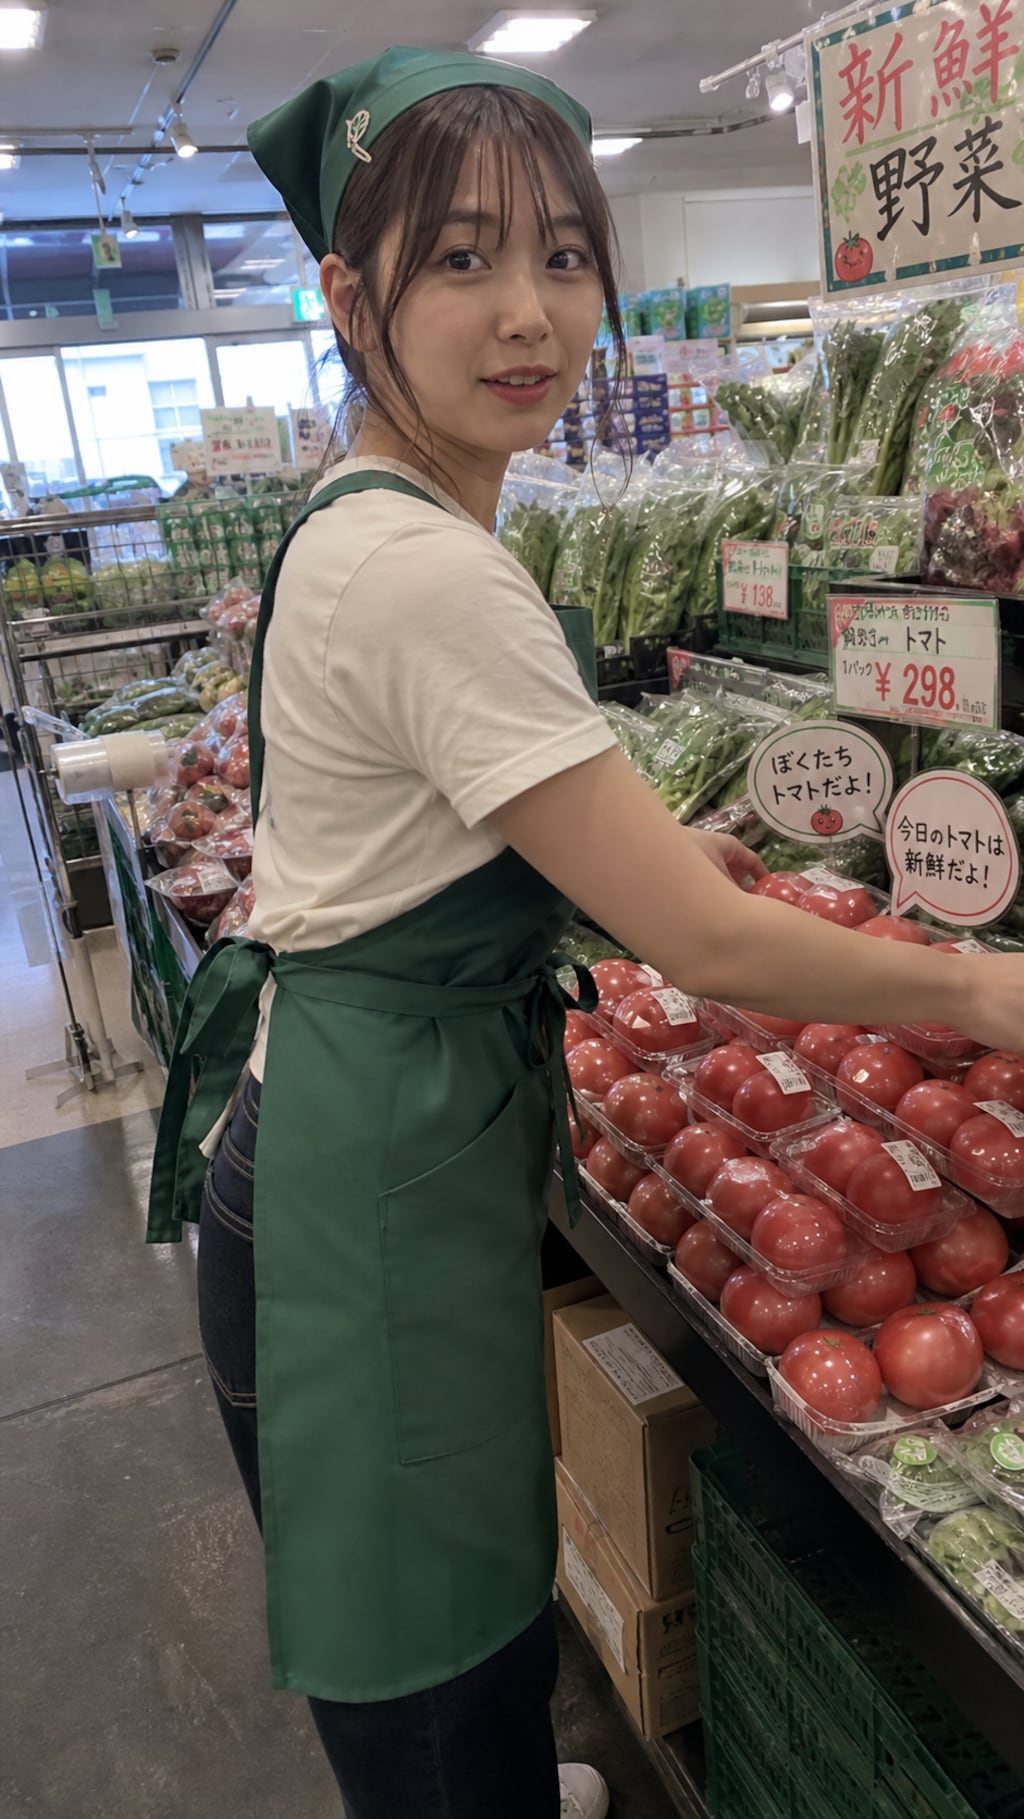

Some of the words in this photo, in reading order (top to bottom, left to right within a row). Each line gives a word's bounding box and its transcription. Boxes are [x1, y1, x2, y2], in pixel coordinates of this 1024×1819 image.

[838, 0, 1020, 145] 新鮮
[870, 116, 1022, 241] 野菜
[752, 584, 773, 608] 138
[907, 626, 946, 654] トマト
[843, 660, 872, 676] 1パック
[771, 746, 852, 775] ぼくたち
[773, 772, 871, 805] トマトだよ!
[897, 816, 1005, 856] 今日のトマトは
[905, 848, 989, 888] 新鮮だよ!
